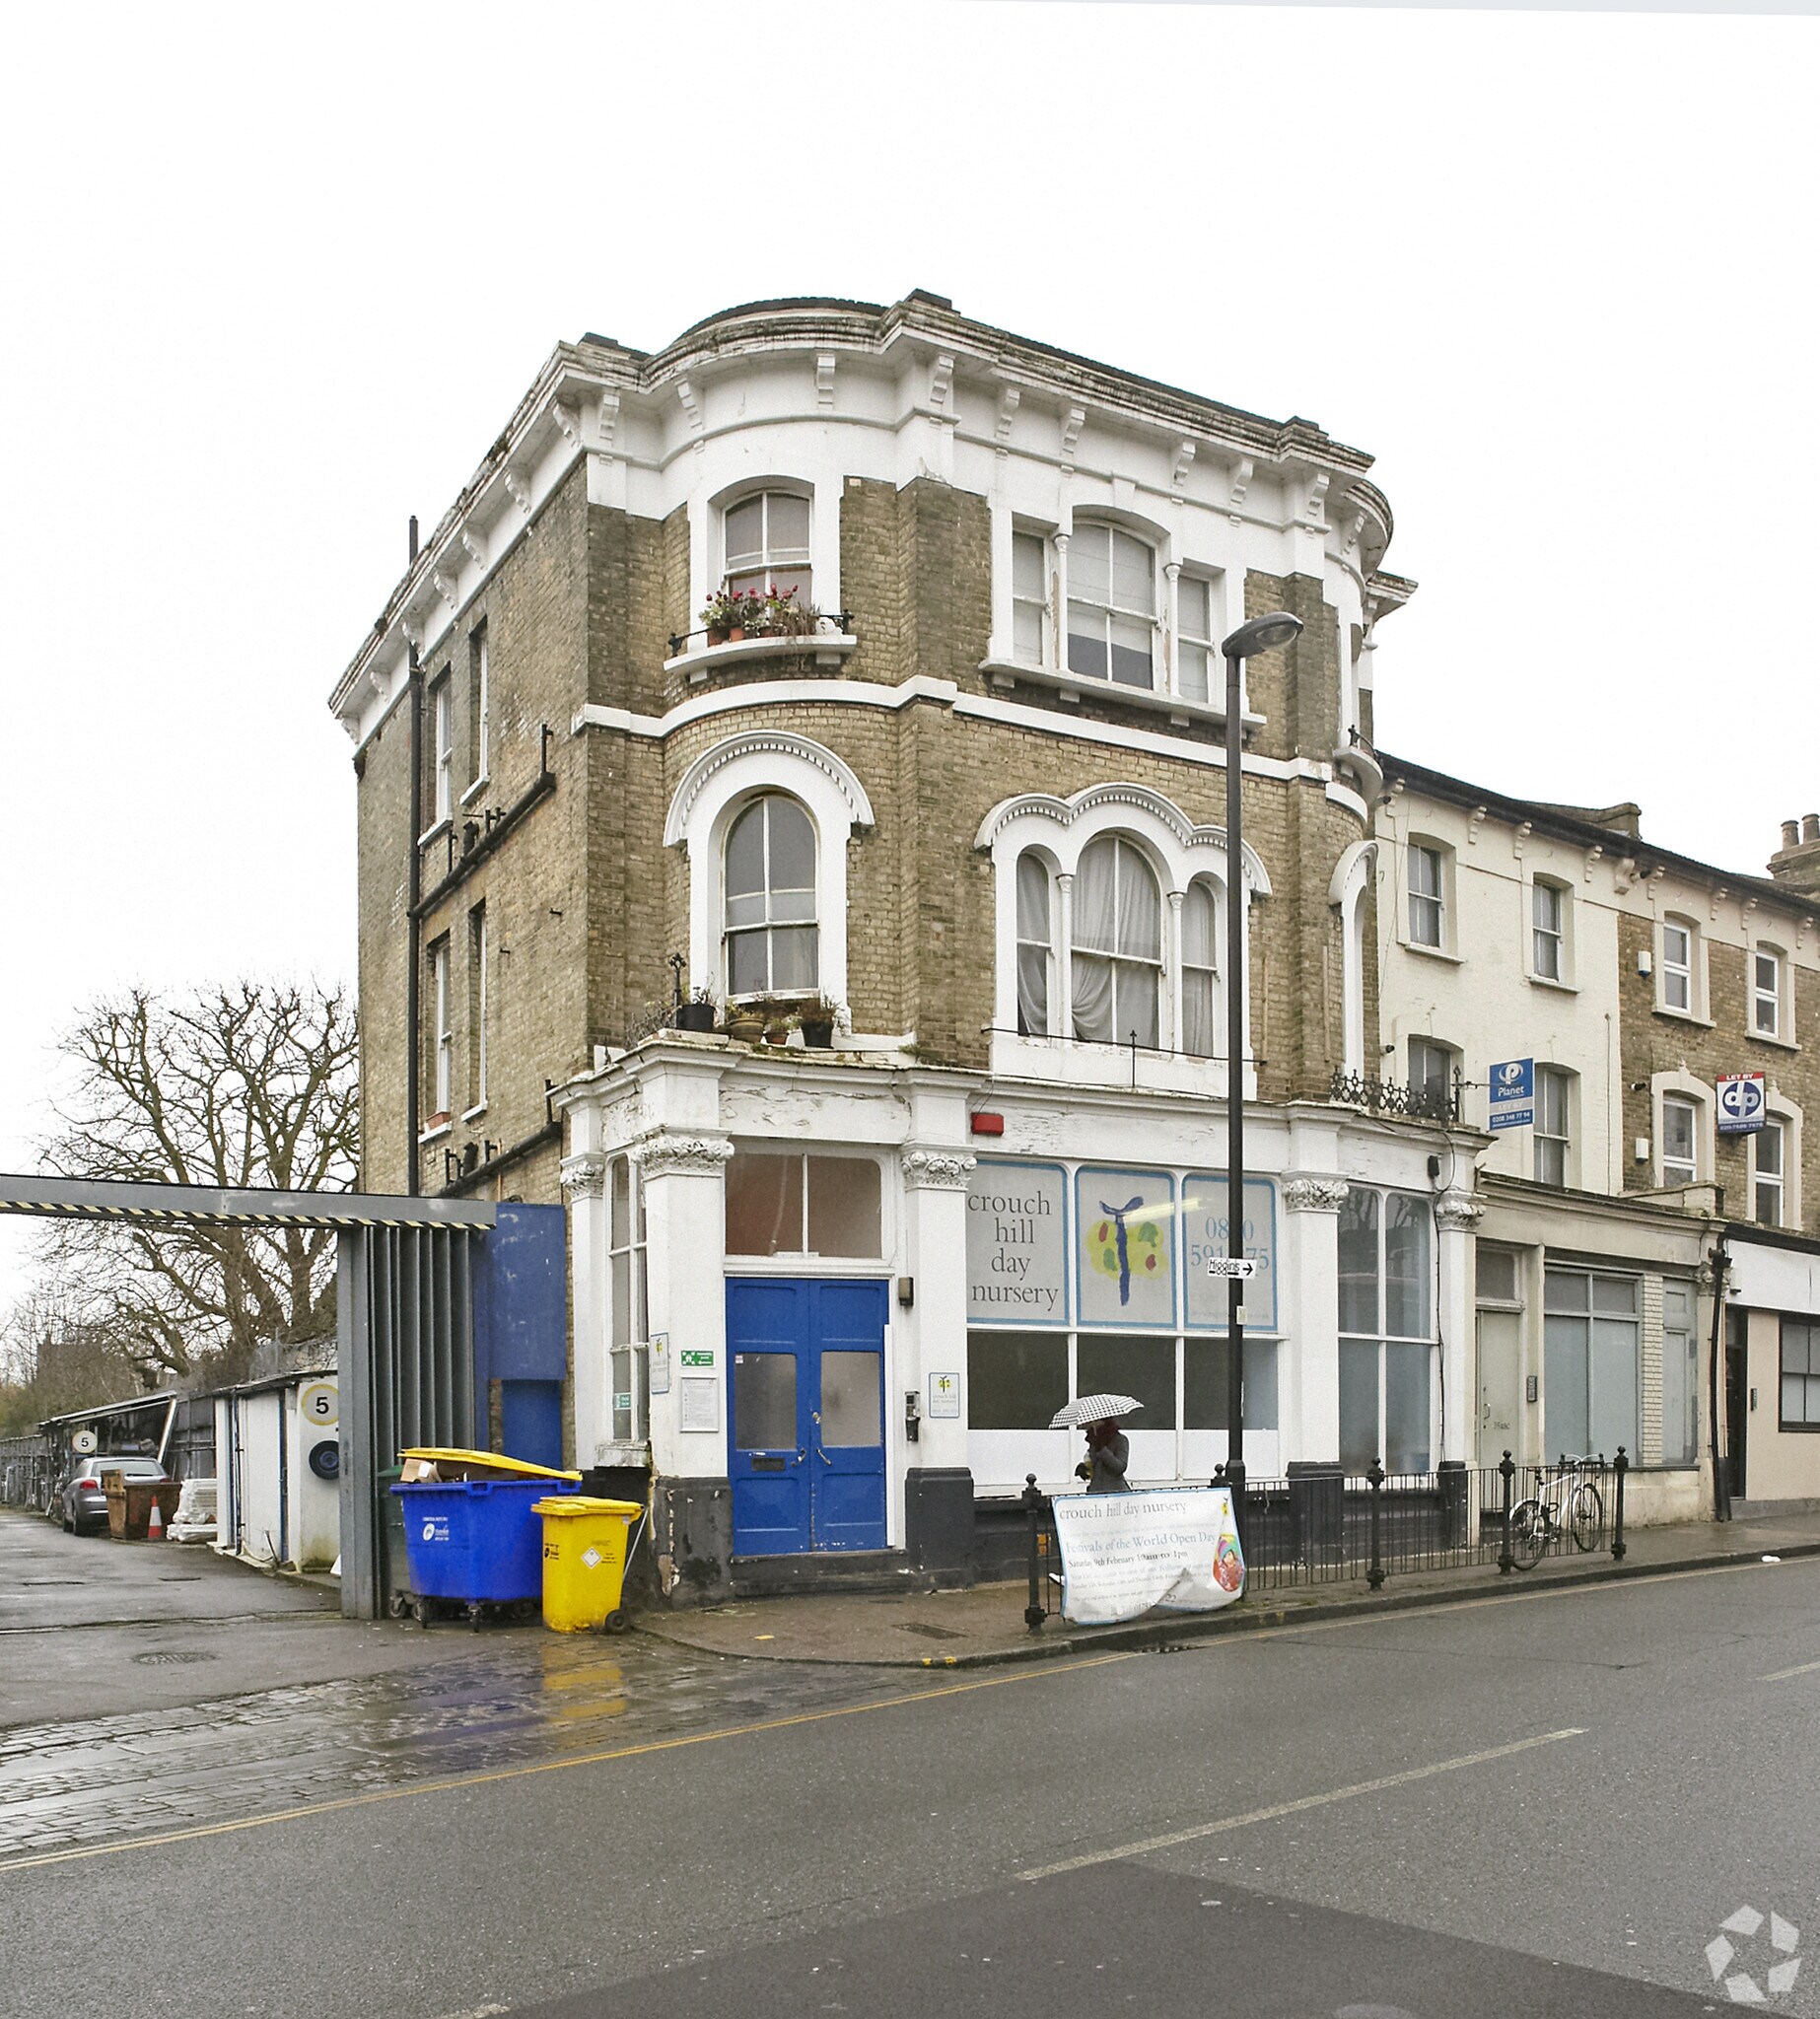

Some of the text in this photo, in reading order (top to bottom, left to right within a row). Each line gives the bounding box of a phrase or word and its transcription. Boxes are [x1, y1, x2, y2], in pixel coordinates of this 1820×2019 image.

[1499, 1085, 1524, 1097] Planet
[1499, 1102, 1511, 1111] LET
[968, 1191, 1051, 1215] crouch
[995, 1218, 1034, 1243] hill
[1206, 1218, 1254, 1241] 080
[991, 1248, 1030, 1281] day
[1209, 1260, 1240, 1276] Higgins
[971, 1285, 1059, 1311] nursery
[315, 1397, 329, 1414] 5
[81, 1436, 89, 1447] 5
[1059, 1501, 1186, 1519] crouch hill day nursery
[1105, 1539, 1116, 1551] of
[1116, 1538, 1131, 1549] the
[1133, 1533, 1167, 1547] World
[1169, 1532, 1197, 1546] Open
[1199, 1531, 1215, 1545] Day
[1093, 1558, 1105, 1566] 9th
[1106, 1556, 1135, 1566] February
[1173, 1550, 1188, 1560] 1pm
